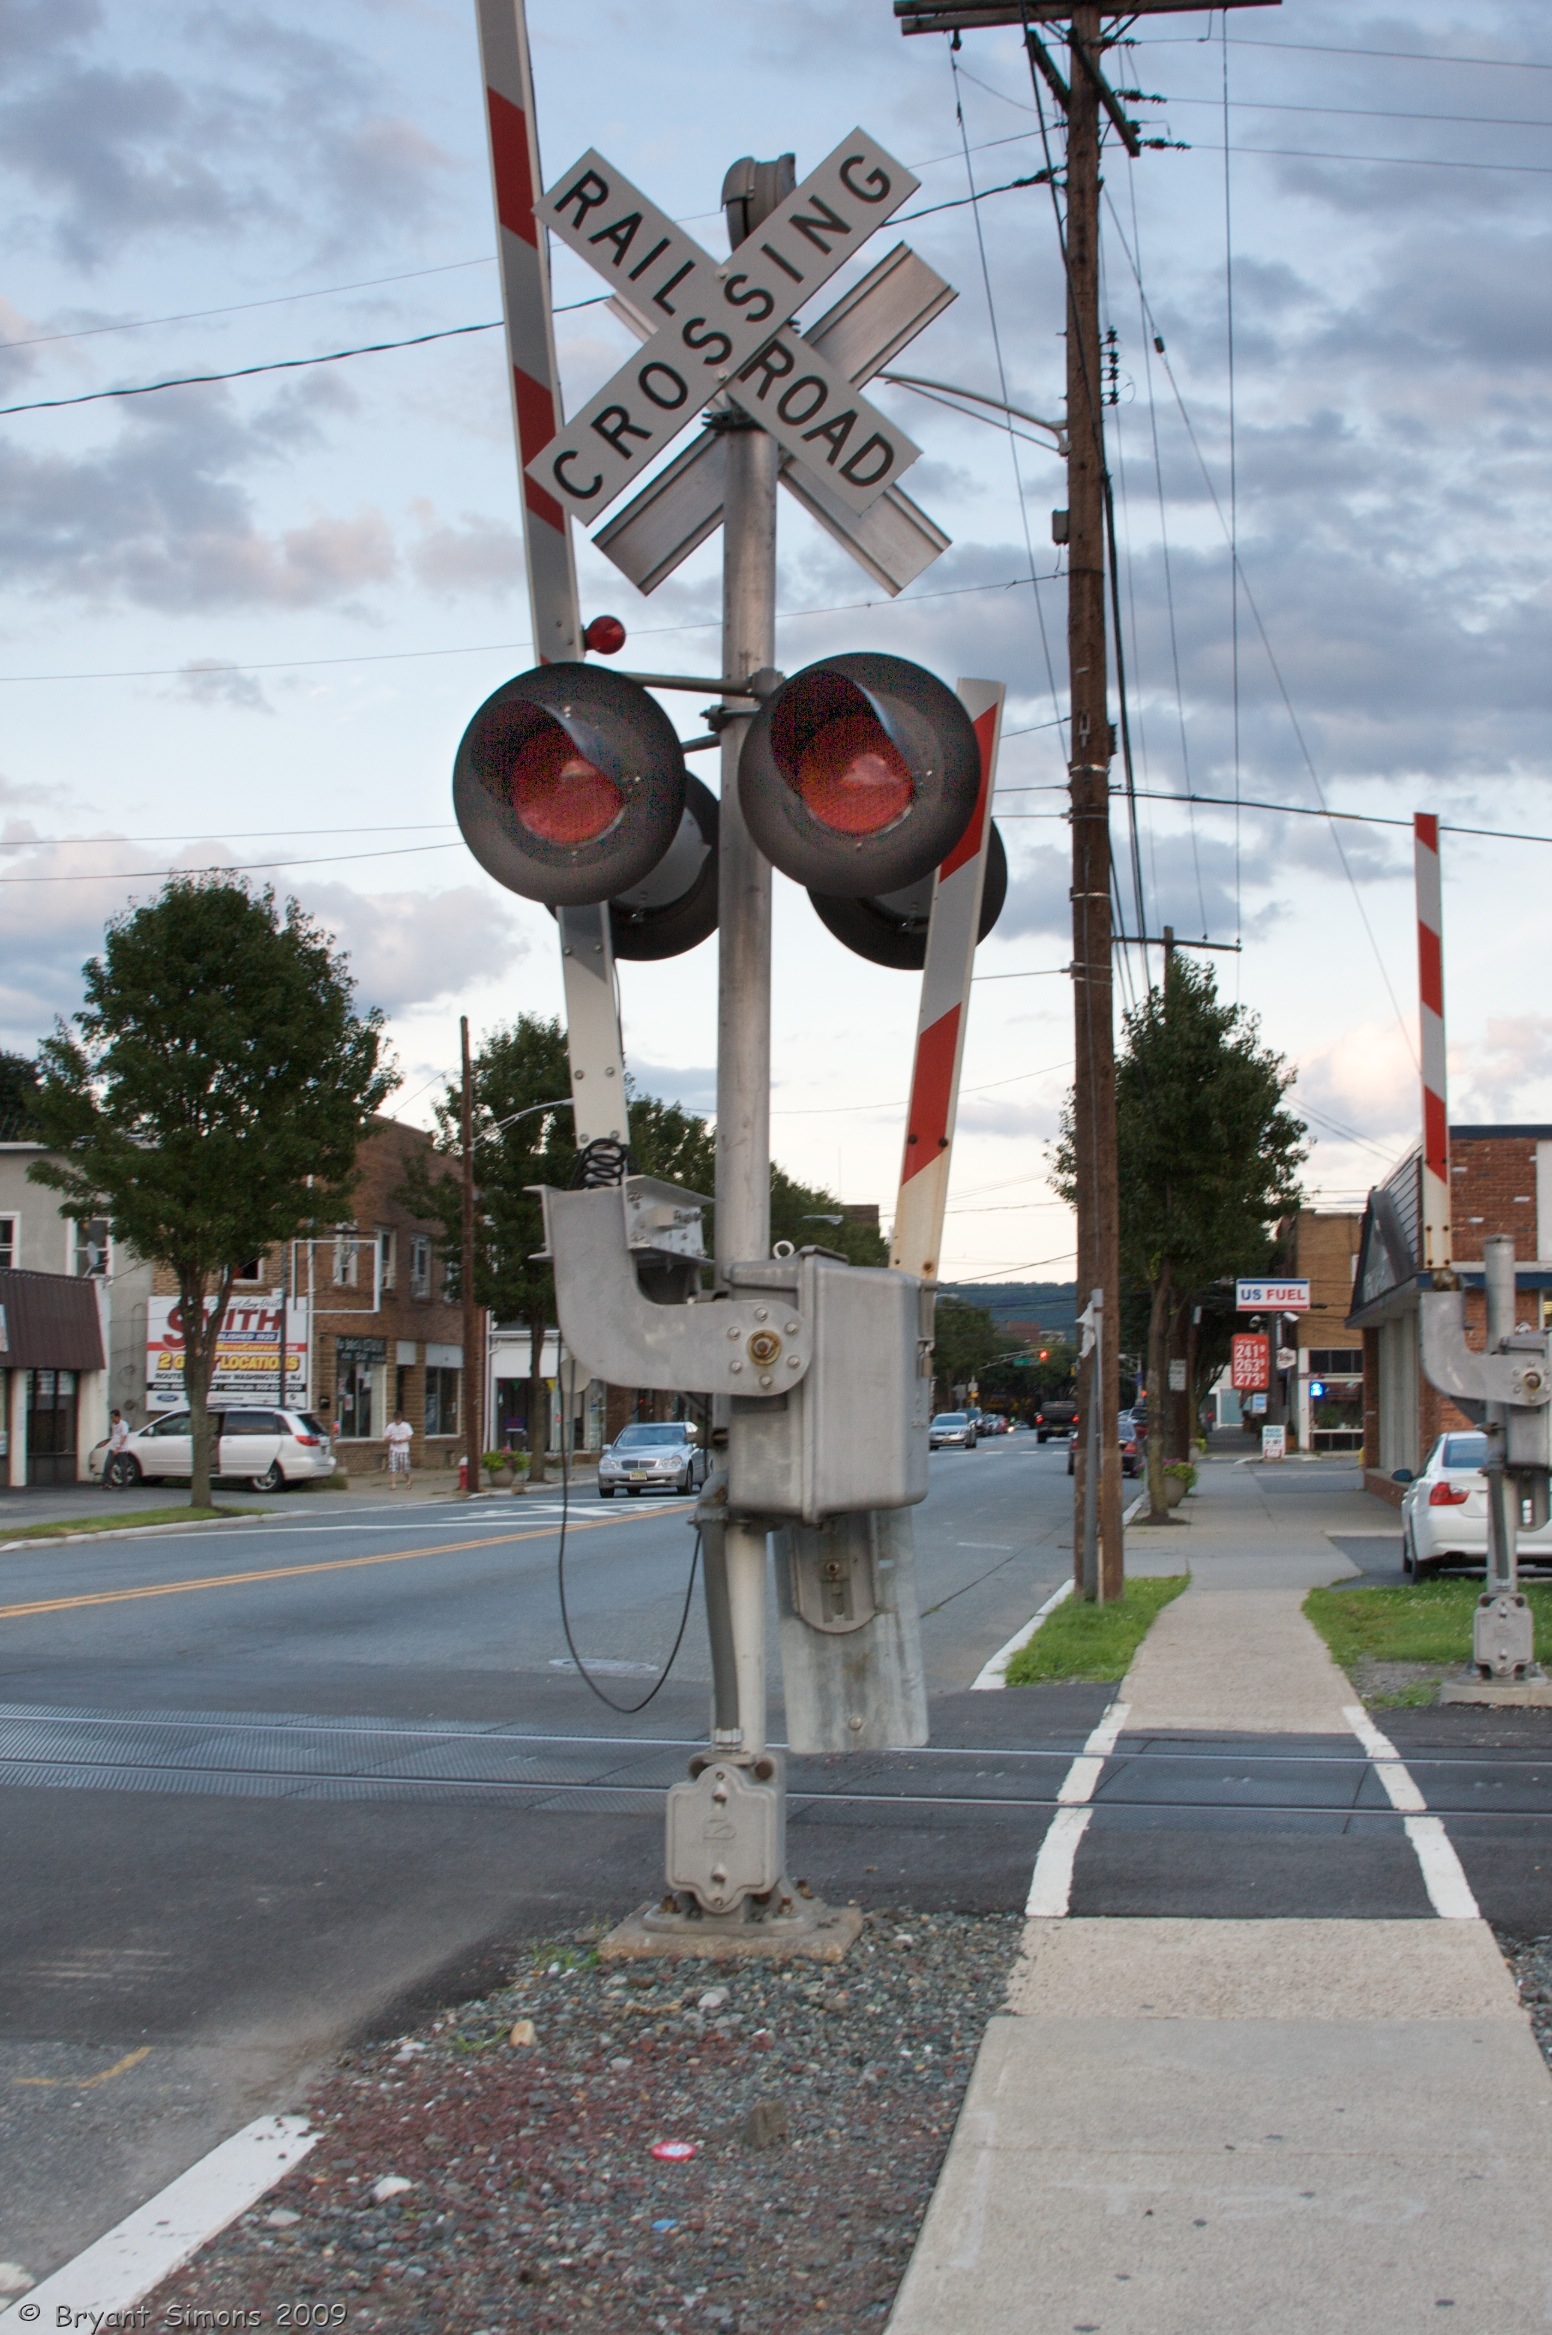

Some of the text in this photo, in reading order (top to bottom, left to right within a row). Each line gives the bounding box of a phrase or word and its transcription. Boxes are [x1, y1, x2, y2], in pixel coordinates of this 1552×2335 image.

[552, 155, 892, 500] CROSSING
[1241, 1289, 1306, 1301] US FUEL
[163, 1305, 284, 1347] SITH
